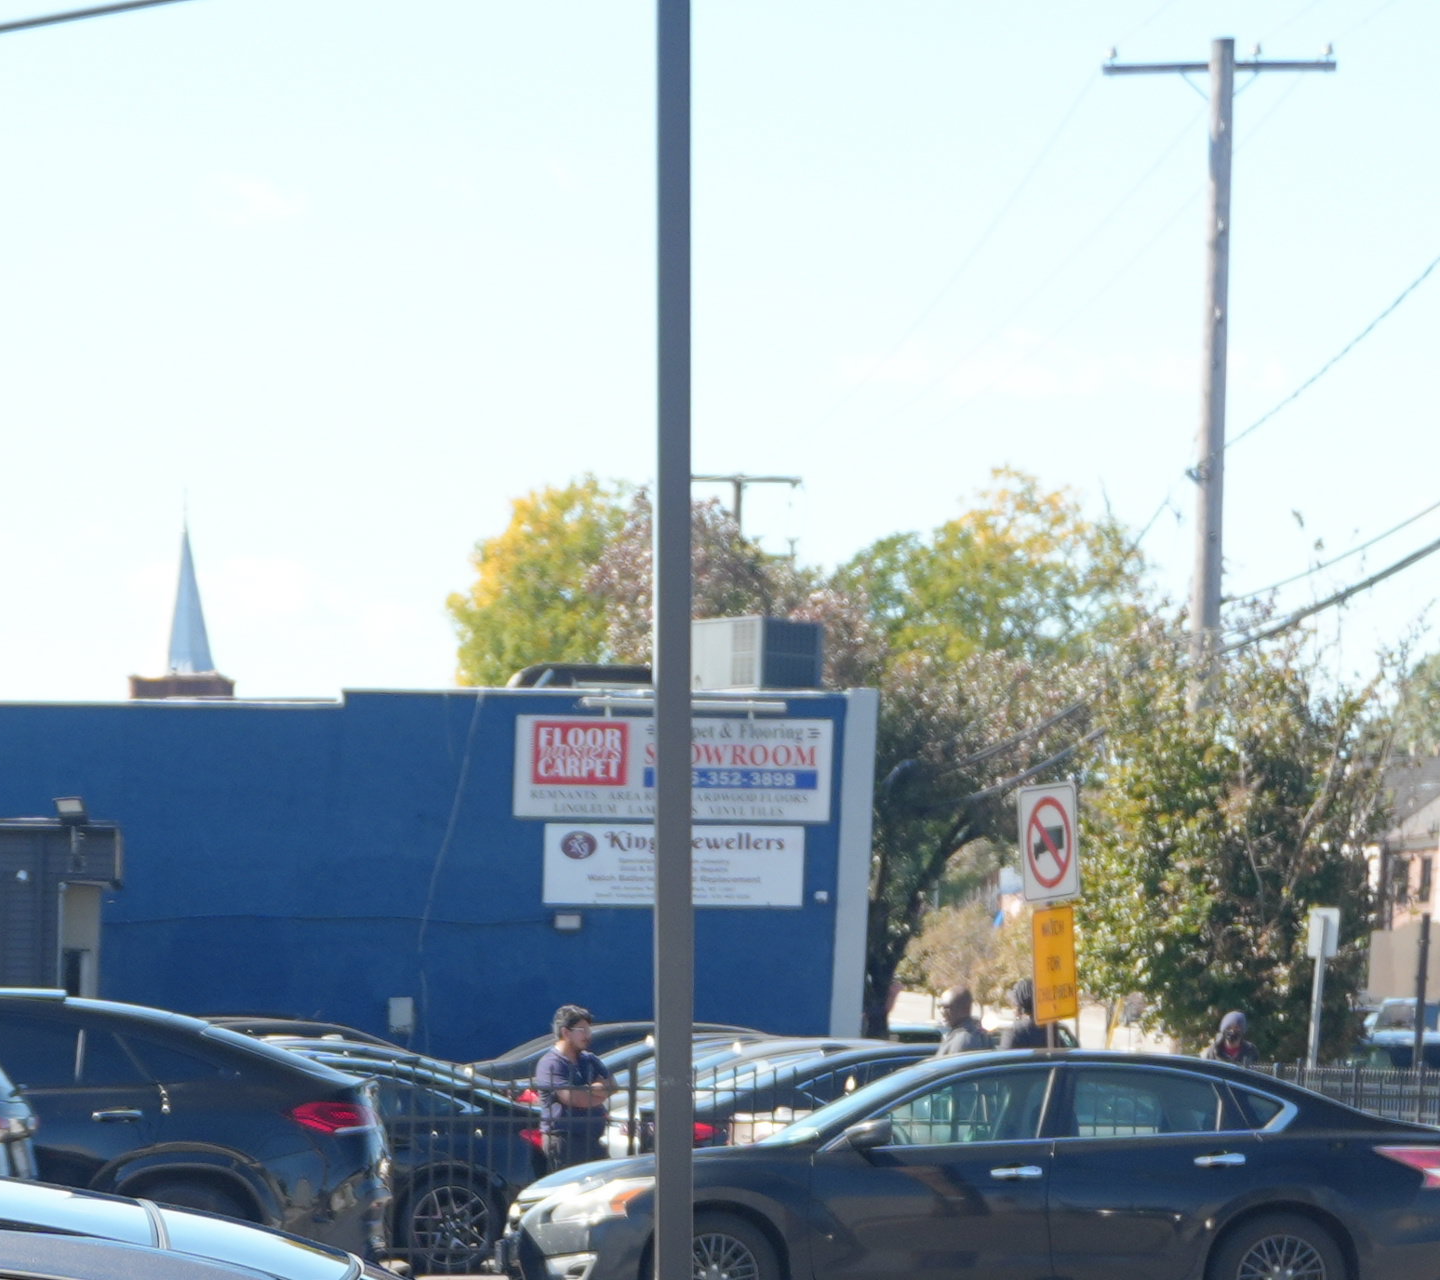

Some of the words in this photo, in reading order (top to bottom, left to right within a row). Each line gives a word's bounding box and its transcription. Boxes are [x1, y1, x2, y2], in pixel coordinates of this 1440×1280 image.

[538, 726, 622, 750] FLOOR
[720, 722, 733, 739] &
[739, 723, 804, 744] Flooring
[537, 756, 621, 779] CARPET
